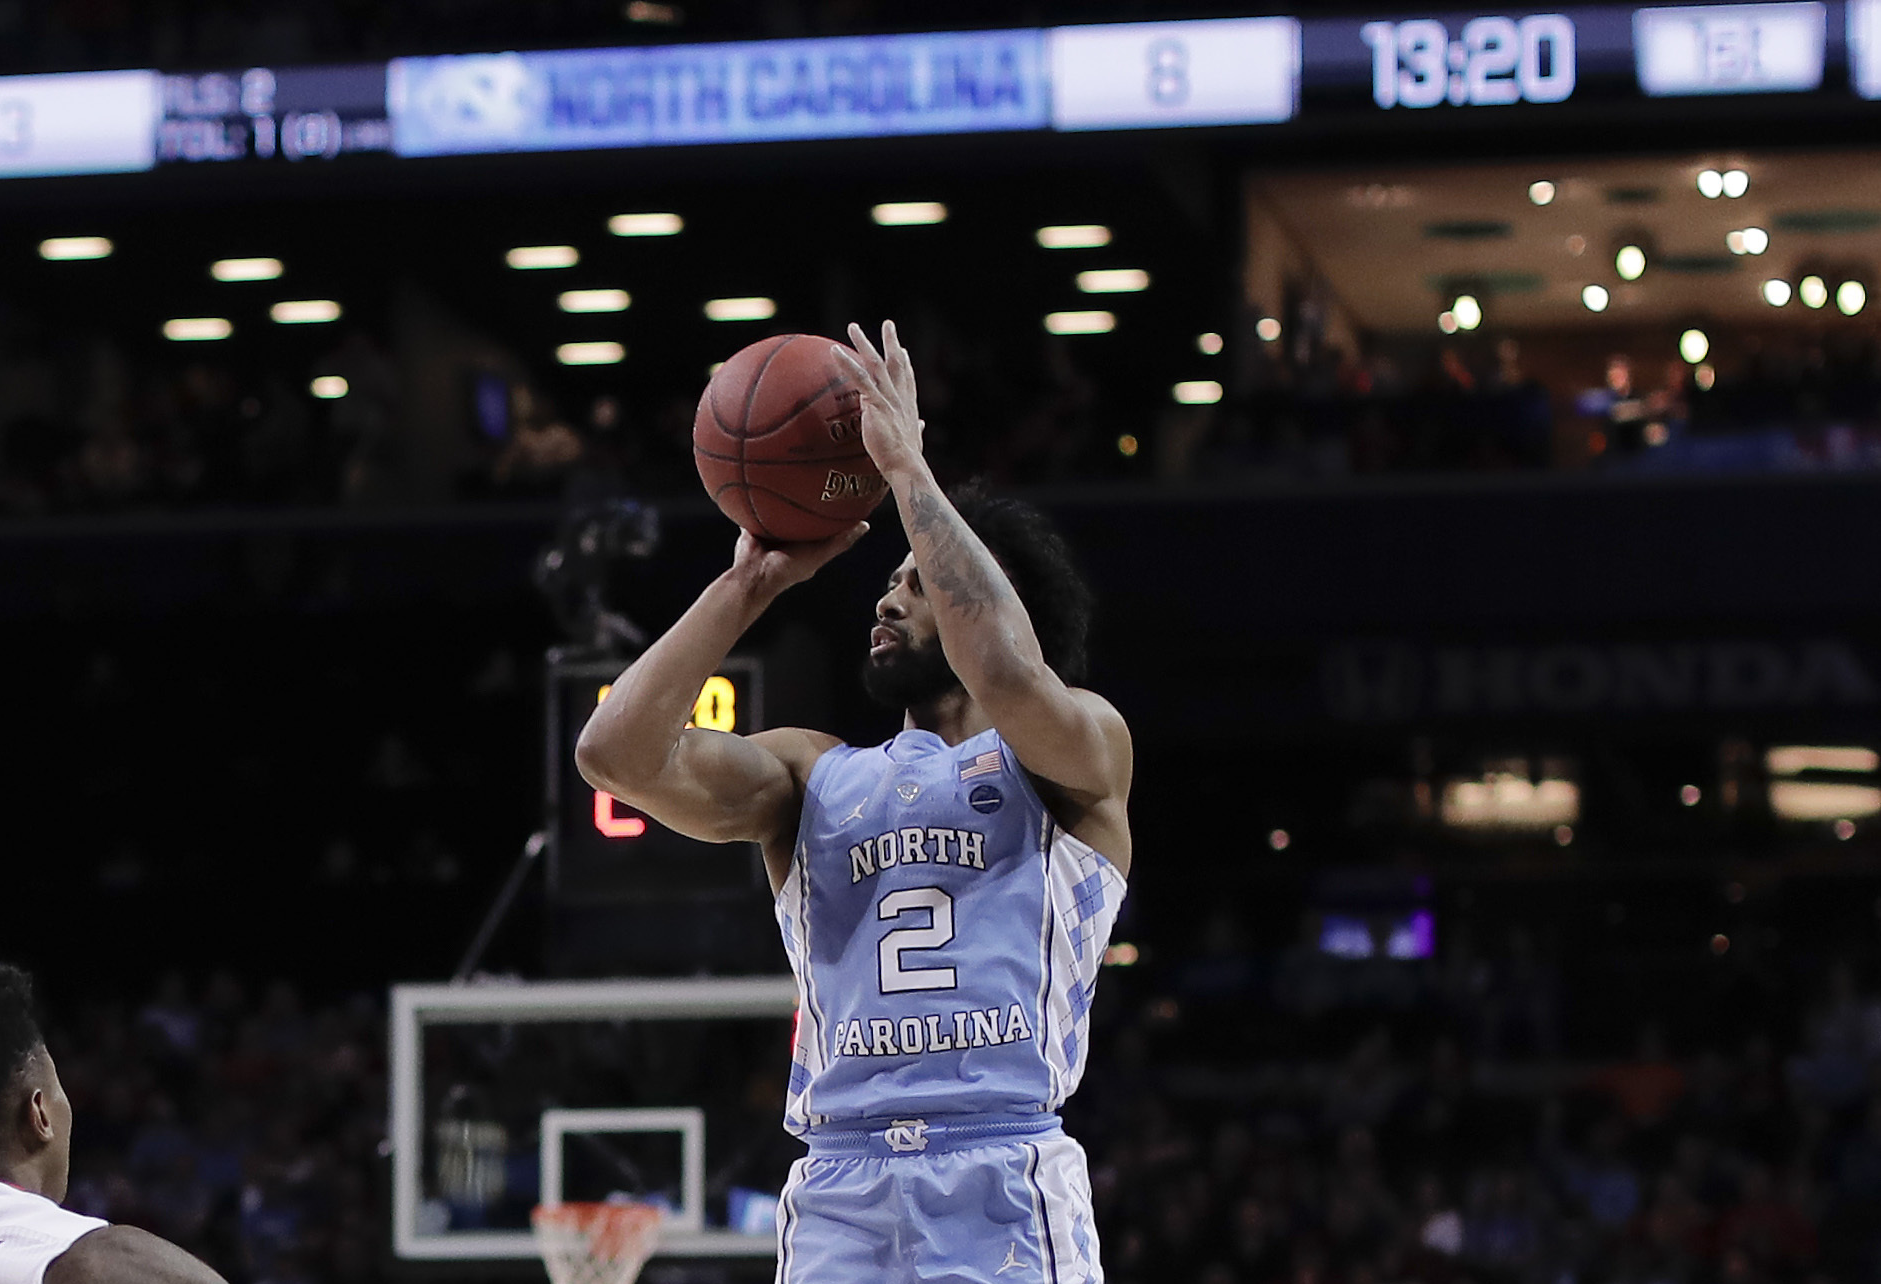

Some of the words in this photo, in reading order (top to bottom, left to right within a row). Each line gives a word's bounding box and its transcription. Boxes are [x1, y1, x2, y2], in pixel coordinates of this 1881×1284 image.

[545, 63, 729, 127] NORTH
[744, 50, 1023, 117] CAROLINA
[1145, 36, 1191, 106] 8
[1360, 14, 1576, 109] 13:20
[849, 827, 985, 884] NORTH
[878, 887, 956, 994] 2
[834, 1003, 1032, 1057] CAROLINA
